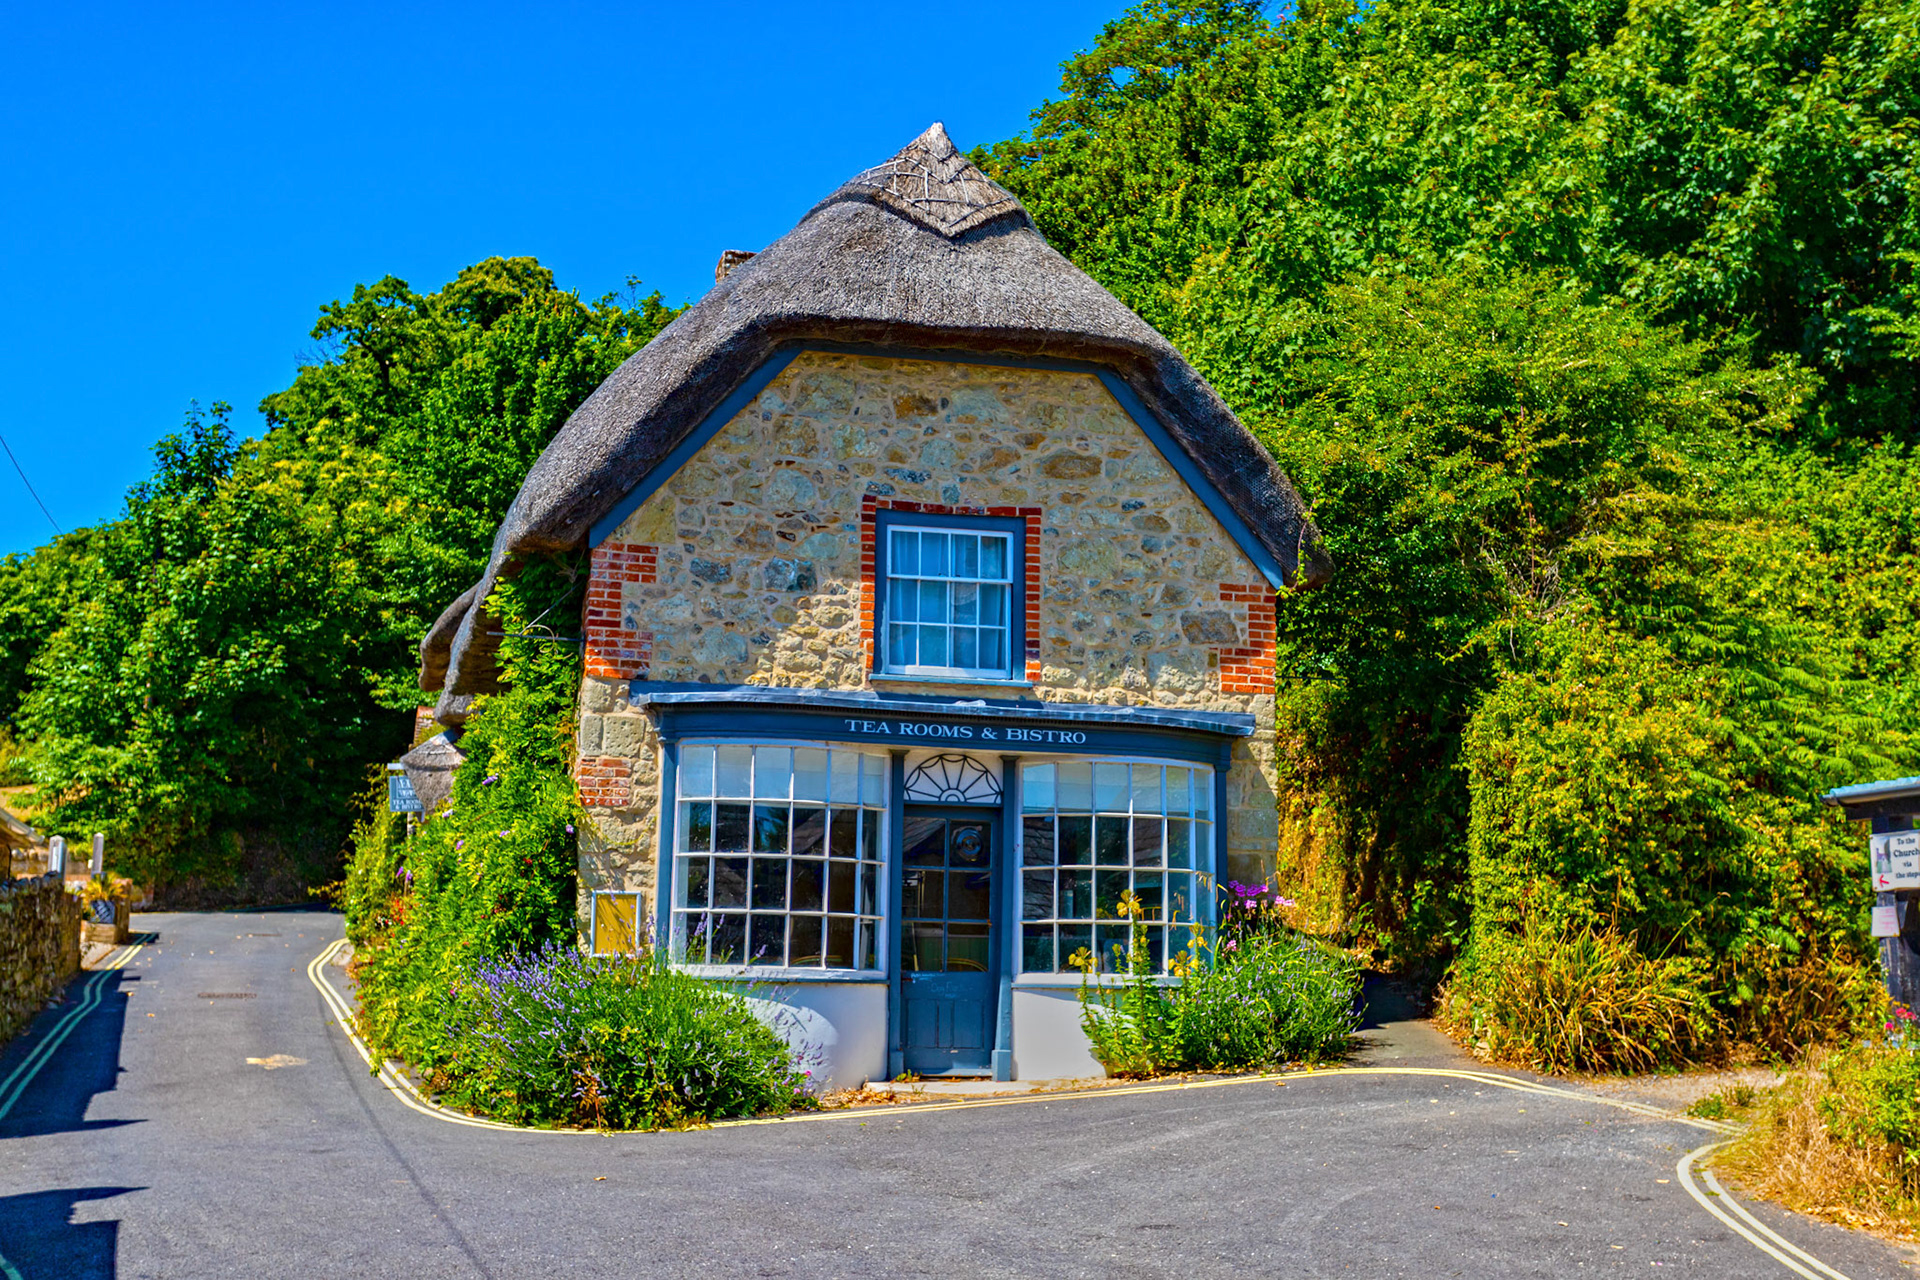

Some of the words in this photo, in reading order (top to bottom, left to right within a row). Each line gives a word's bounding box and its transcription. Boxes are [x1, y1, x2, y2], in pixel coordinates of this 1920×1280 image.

[845, 719, 891, 734] TEA
[899, 722, 973, 739] ROOMS
[981, 727, 997, 740] &
[1005, 728, 1087, 744] BISTRO
[1893, 848, 1920, 857] Church
